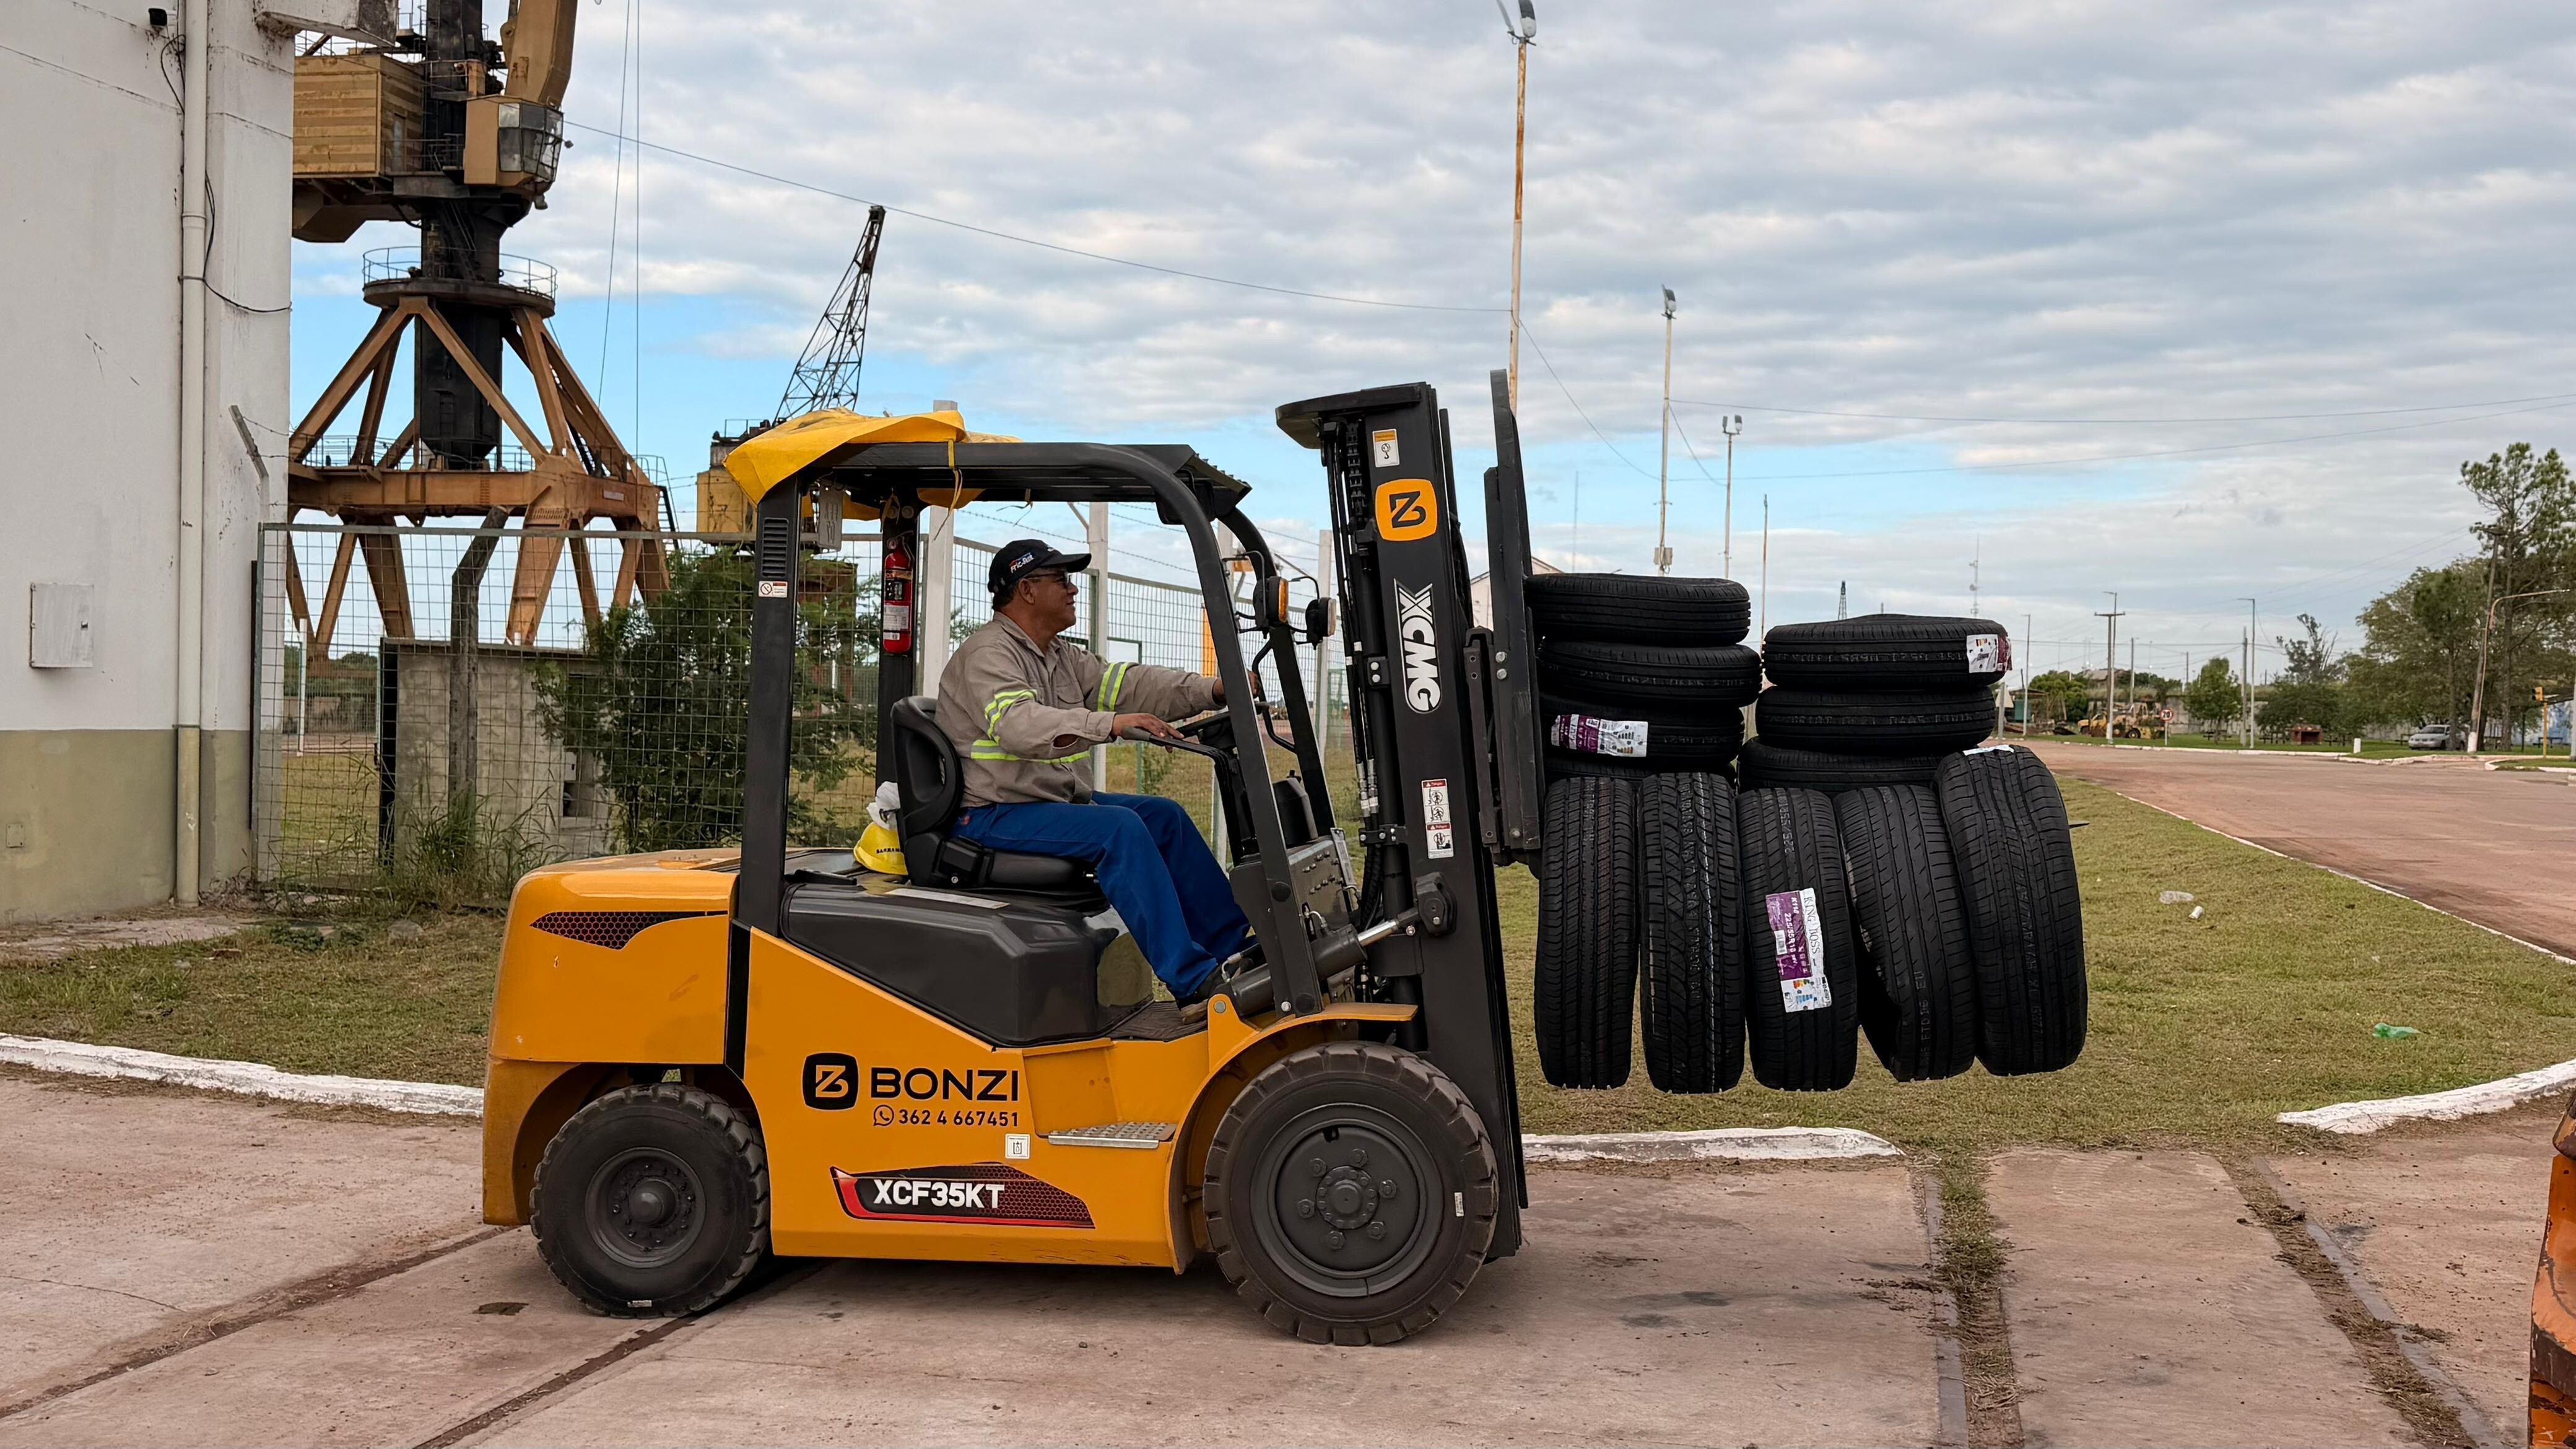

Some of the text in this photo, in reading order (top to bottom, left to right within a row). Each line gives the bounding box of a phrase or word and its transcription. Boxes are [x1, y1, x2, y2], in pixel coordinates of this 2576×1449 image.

[1395, 580, 1441, 711] XCMG
[1803, 896, 1816, 921] KING
[871, 1067, 1019, 1102] BONZI
[899, 1109, 1019, 1127] 362 4 667451
[873, 1179, 1005, 1209] XCF35KT
